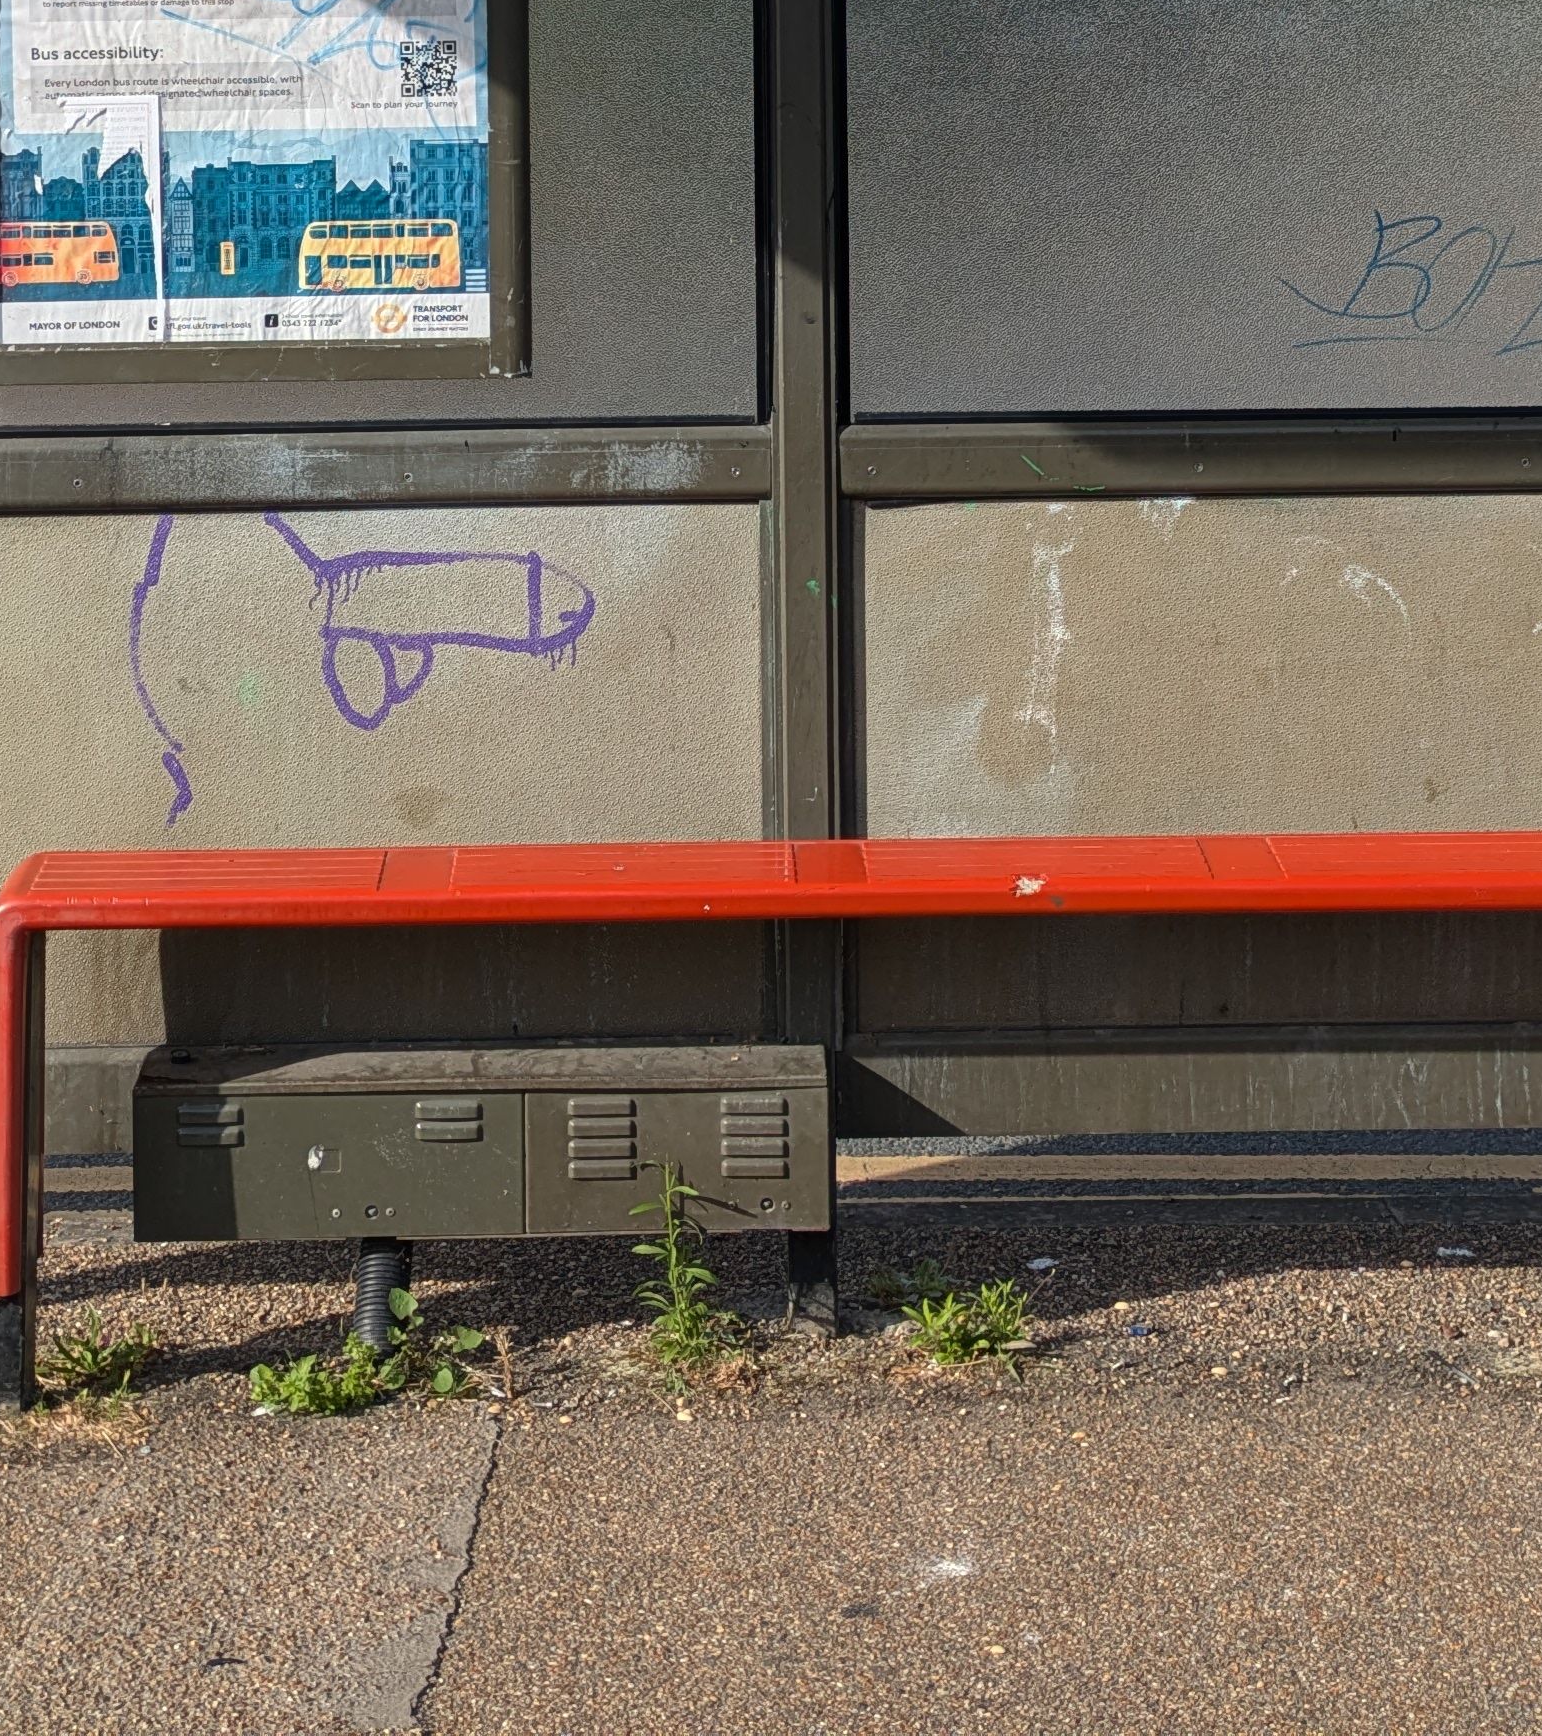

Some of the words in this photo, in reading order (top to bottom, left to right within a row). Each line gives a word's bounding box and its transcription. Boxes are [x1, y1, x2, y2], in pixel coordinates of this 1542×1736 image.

[52, 0, 77, 9] report
[78, 0, 108, 9] missing
[109, 0, 149, 8] timetables
[160, 0, 190, 8] damage
[191, 0, 200, 7] to
[30, 47, 59, 61] Bus
[62, 45, 164, 63] accessibility:
[44, 78, 72, 89] Every
[73, 77, 111, 88] London
[112, 77, 131, 87] bus
[132, 77, 159, 87] route
[161, 76, 170, 86] is
[171, 75, 225, 86] wheelchair
[226, 75, 278, 87] accessible,
[280, 74, 303, 84] with
[149, 88, 202, 100] designated
[201, 87, 257, 98] wheelchair
[258, 88, 295, 100] spaces.
[383, 101, 403, 110] plan
[404, 101, 424, 109] your
[425, 100, 459, 109] journey
[412, 304, 463, 313] TRANSPORT
[303, 319, 317, 327] 222
[412, 314, 430, 322] FOR
[431, 314, 469, 322] LONDON
[29, 322, 61, 330] MAYOR
[64, 321, 77, 330] OF
[78, 320, 121, 330] LONDON
